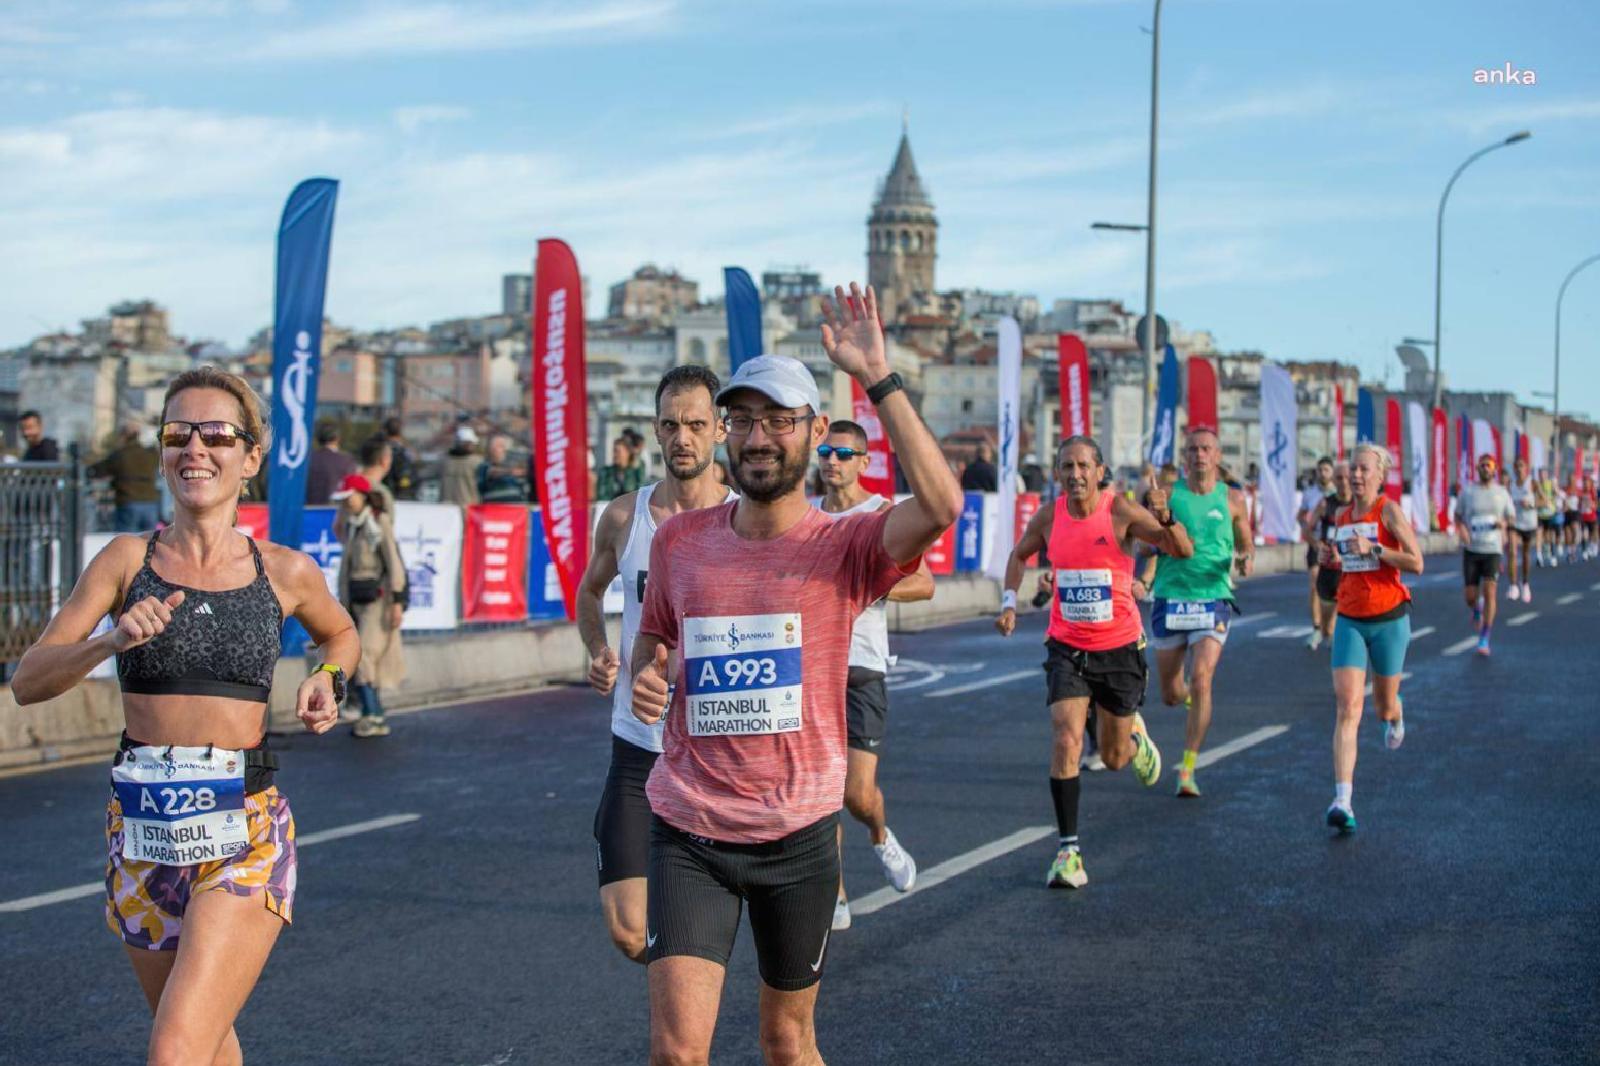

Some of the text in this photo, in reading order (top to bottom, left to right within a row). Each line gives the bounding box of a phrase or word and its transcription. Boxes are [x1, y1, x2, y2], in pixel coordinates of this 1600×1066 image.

[1066, 588, 1101, 601] A 683
[740, 631, 775, 642] BANKASI
[699, 658, 777, 687] A 993
[698, 698, 771, 716] ISTANBUL
[697, 718, 772, 733] MARATHON
[140, 786, 216, 815] A 228
[142, 824, 213, 844] ISTANBUL
[142, 844, 216, 863] MARATHON
